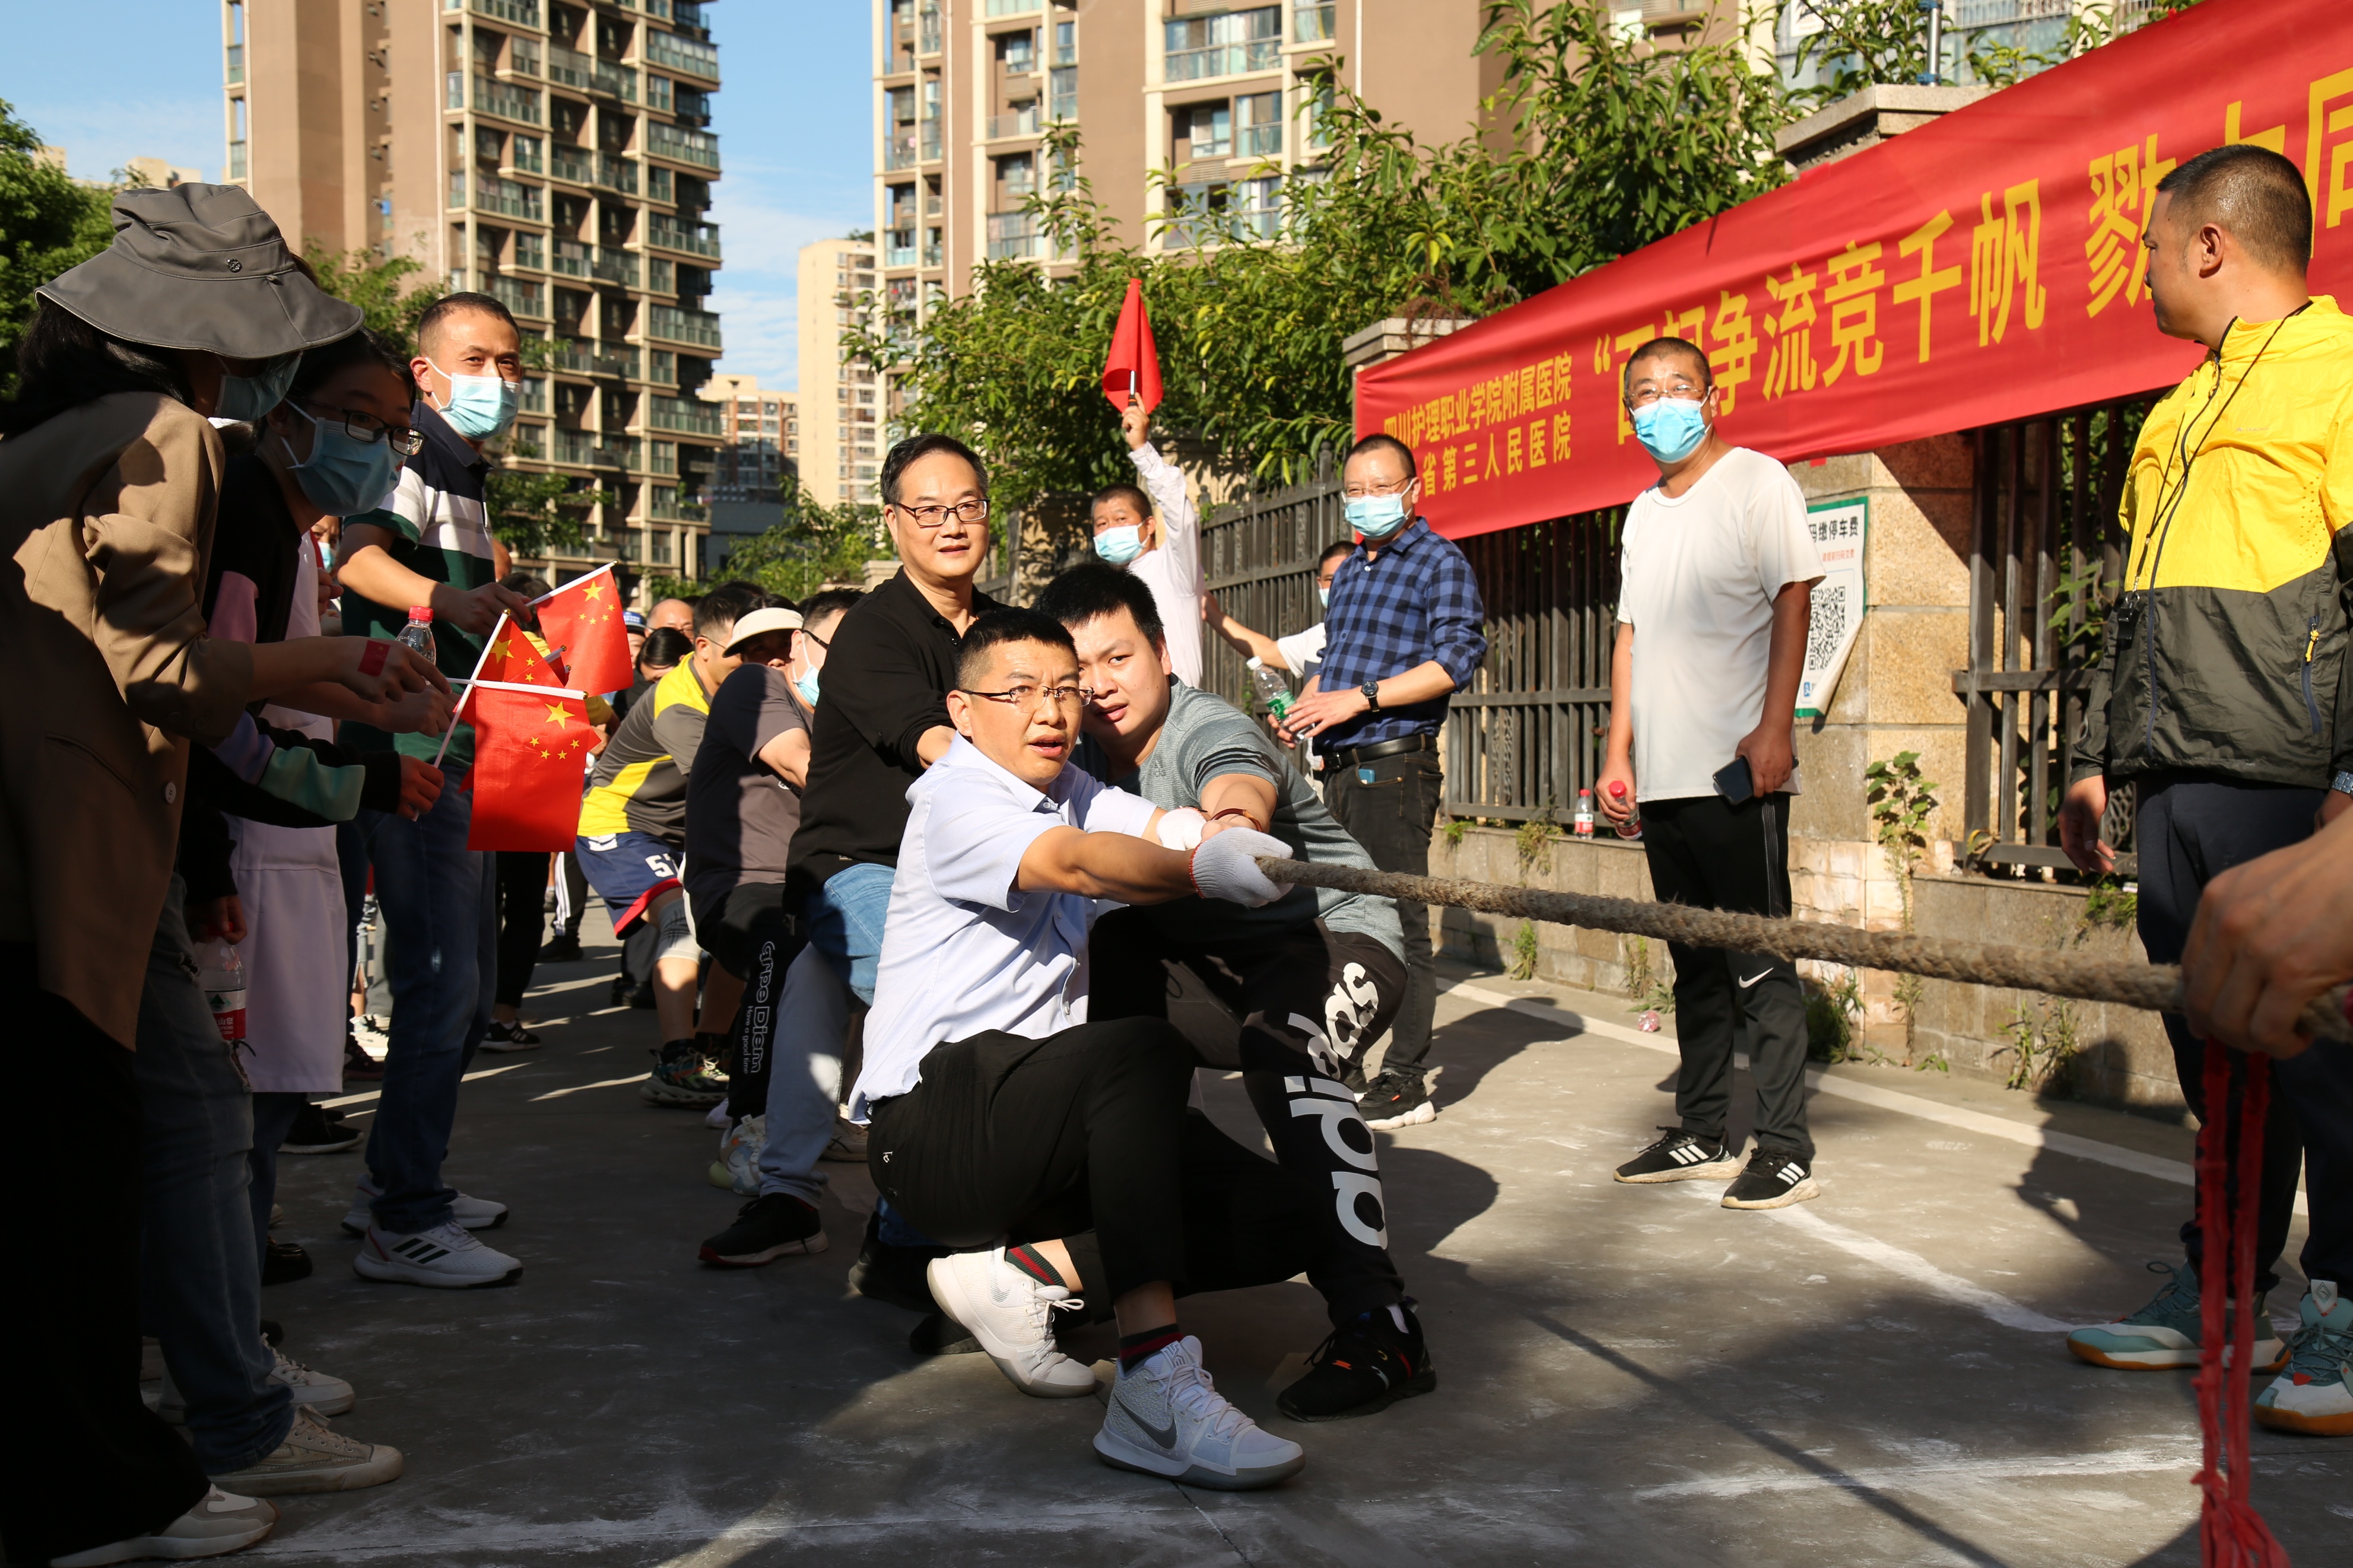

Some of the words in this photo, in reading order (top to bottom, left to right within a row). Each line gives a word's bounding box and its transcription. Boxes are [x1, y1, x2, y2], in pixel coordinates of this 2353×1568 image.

[2085, 66, 2353, 319] 戮同
[215, 1016, 234, 1025] 山泉
[745, 1006, 754, 1026] Have
[742, 1035, 751, 1056] good
[750, 1006, 770, 1073] Diem
[743, 1058, 751, 1074] time
[1284, 962, 1388, 1250] adidas
